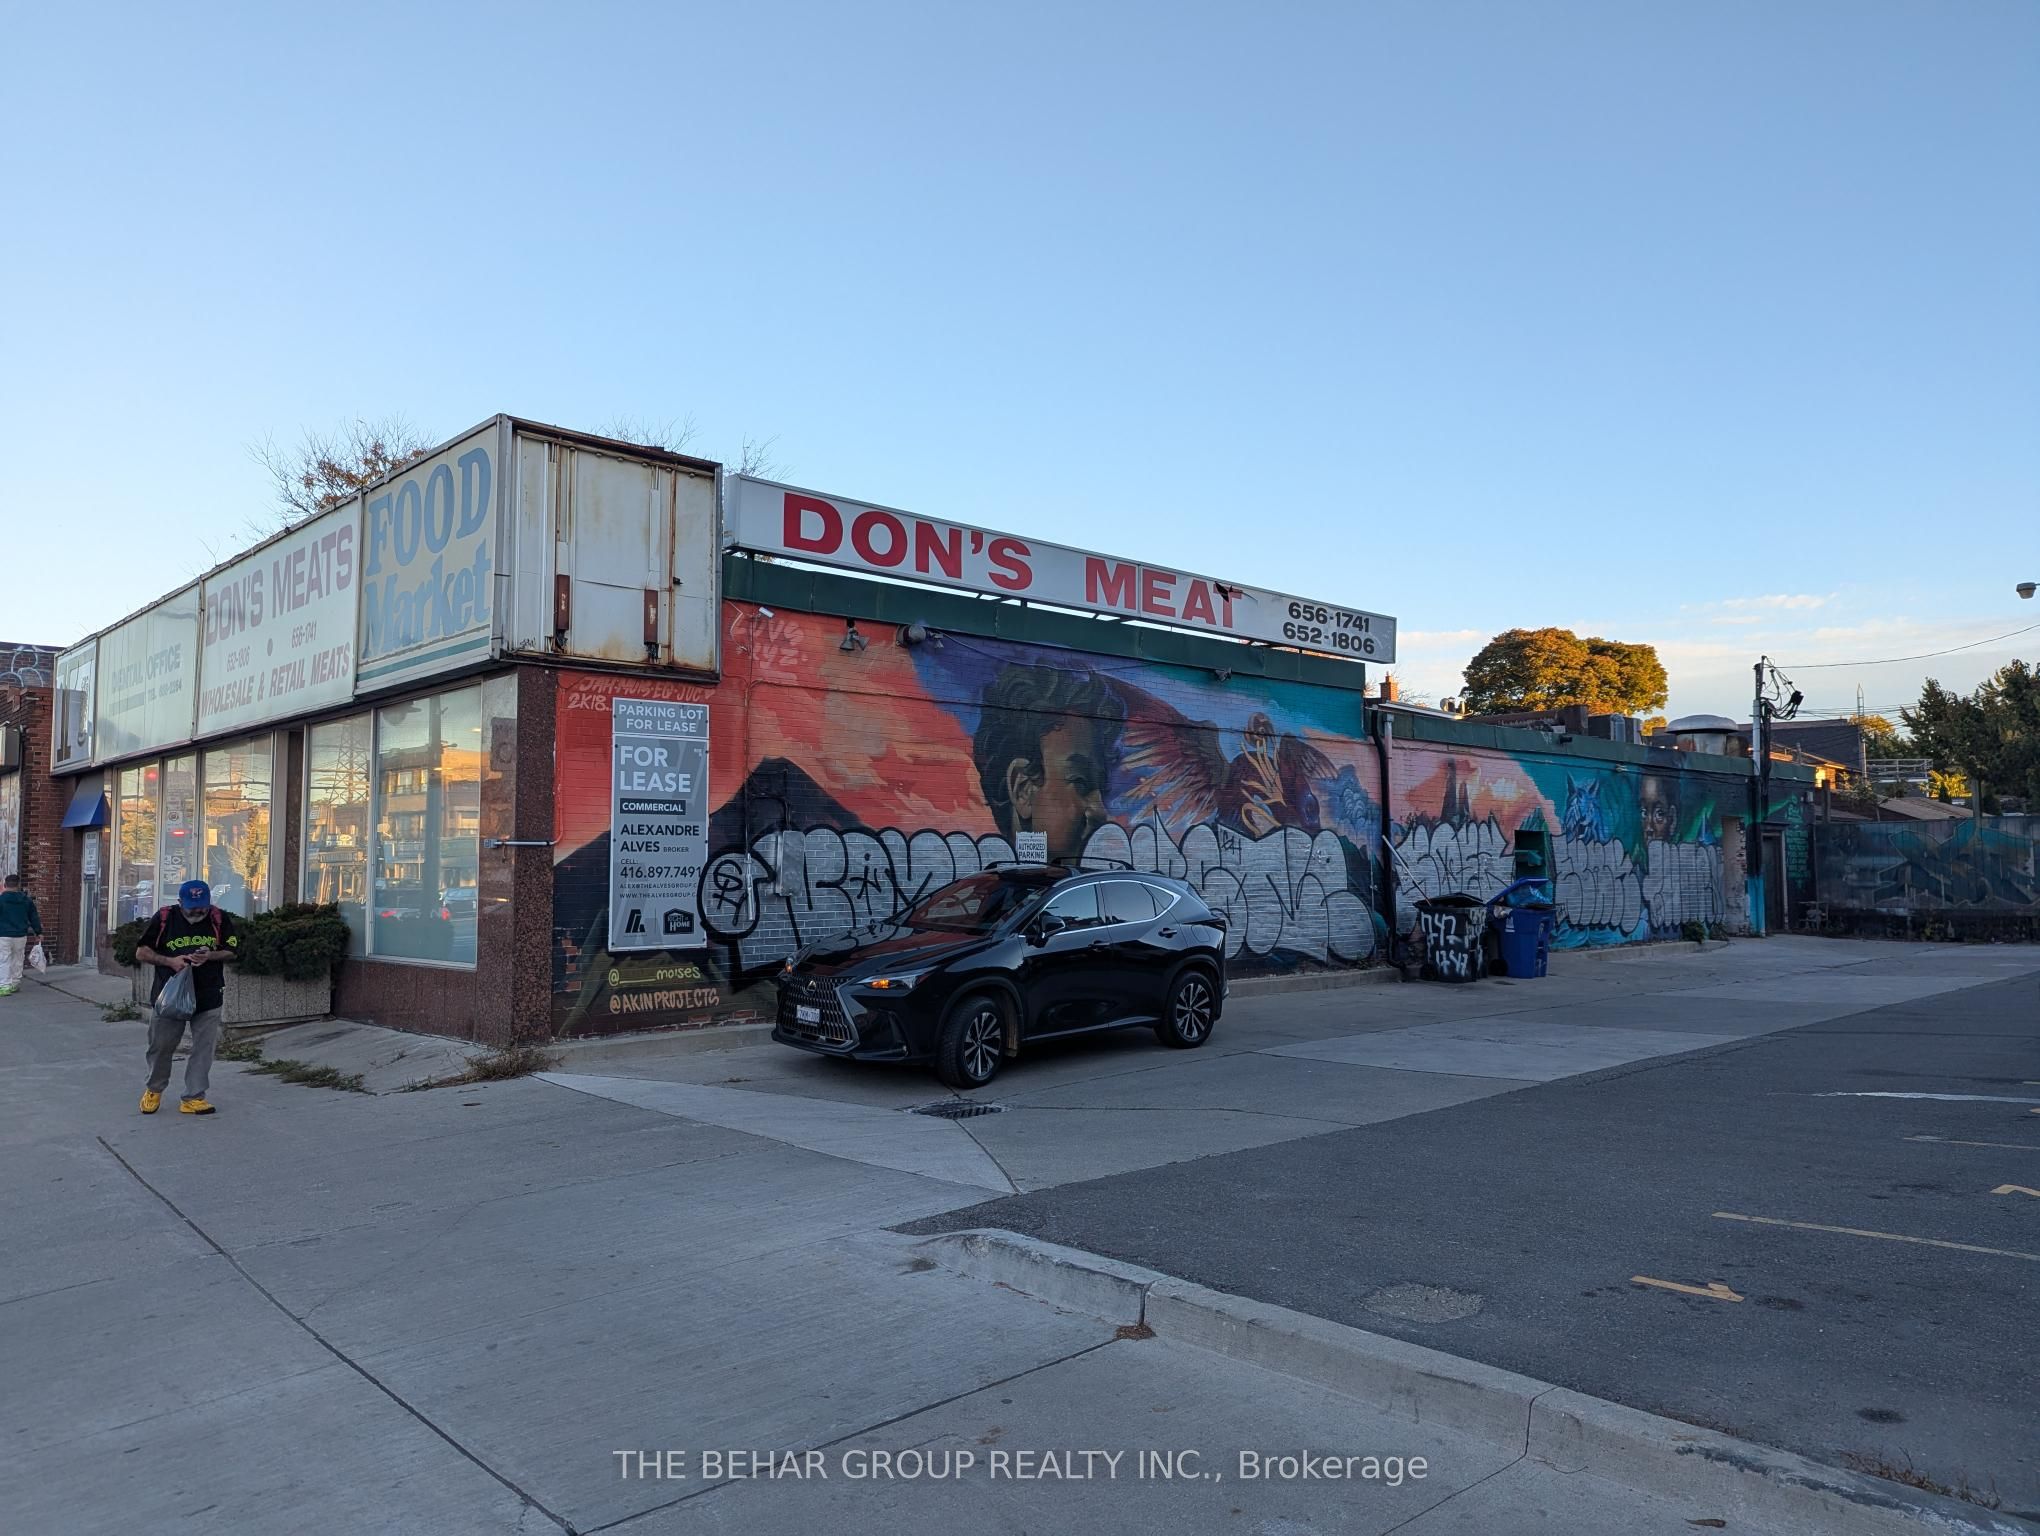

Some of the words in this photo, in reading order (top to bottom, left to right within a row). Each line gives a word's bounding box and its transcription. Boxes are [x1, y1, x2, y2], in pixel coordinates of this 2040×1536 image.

[366, 447, 491, 577] FOOD
[783, 492, 1033, 591] DON'S
[1085, 556, 1243, 628] MEAT
[206, 569, 264, 648] DON'S
[272, 524, 353, 619] MEATS
[361, 537, 491, 660] Market
[1288, 601, 1371, 633] 656-1741
[1282, 621, 1375, 654] 652-1806
[147, 642, 181, 681] OFFICE
[200, 675, 255, 718] WHOLESALE
[257, 671, 265, 702] &
[269, 658, 306, 698] RETAIL
[311, 641, 351, 687] MEATS
[618, 704, 676, 719] PARKING
[680, 709, 704, 720] LOT
[626, 718, 653, 730] FOR
[657, 721, 697, 733] LEASE
[620, 745, 669, 768] FOR
[620, 770, 692, 793] LEASE
[622, 802, 683, 812] COMMERCIAL
[621, 824, 700, 836] ALEXANDRE
[621, 841, 660, 852] ALVES
[1018, 851, 1045, 859] PARKING
[620, 866, 702, 879] 416.897.7491
[669, 920, 691, 932] HOME
[609, 987, 720, 1014] @AKINPROJECTS
